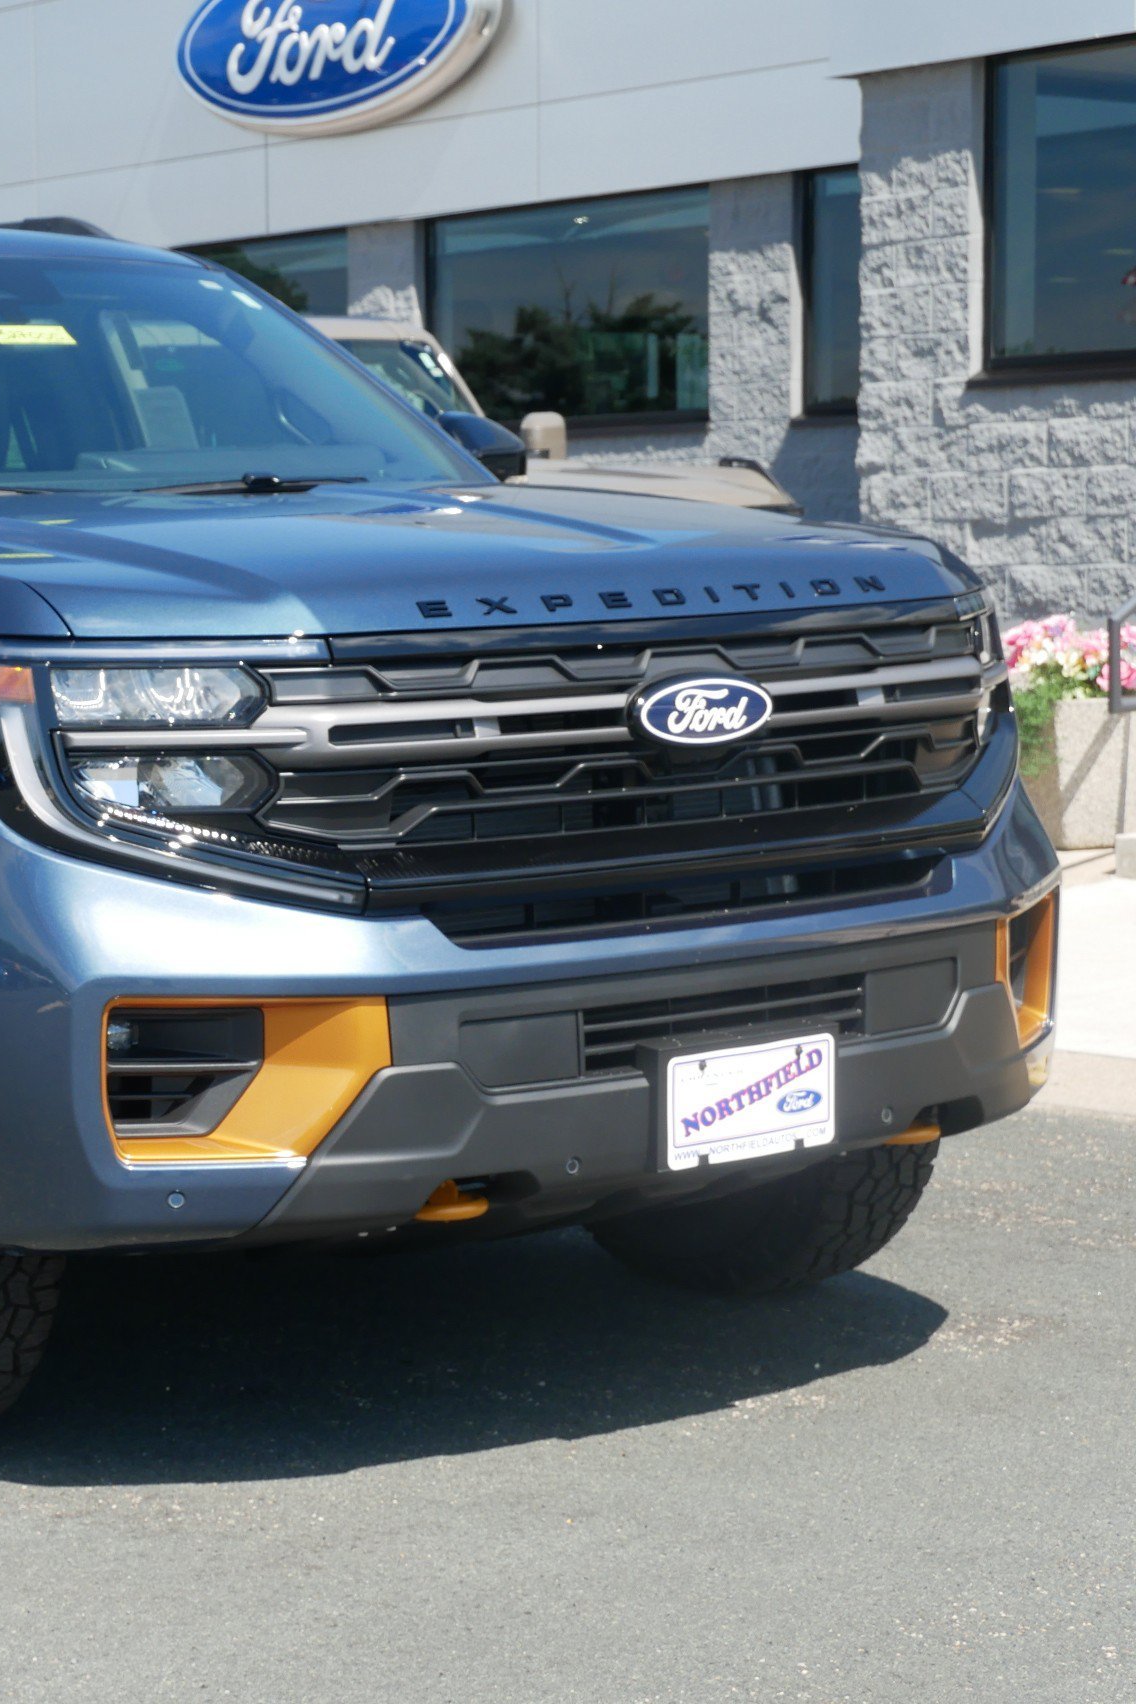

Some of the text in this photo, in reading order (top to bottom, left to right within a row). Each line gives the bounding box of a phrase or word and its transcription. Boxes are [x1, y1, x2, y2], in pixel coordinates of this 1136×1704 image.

[227, 0, 395, 94] Ford
[415, 575, 885, 618] EXPEDITION
[667, 688, 749, 734] Ford
[681, 1048, 823, 1137] NORTHFIELD
[782, 1091, 815, 1112] Ford
